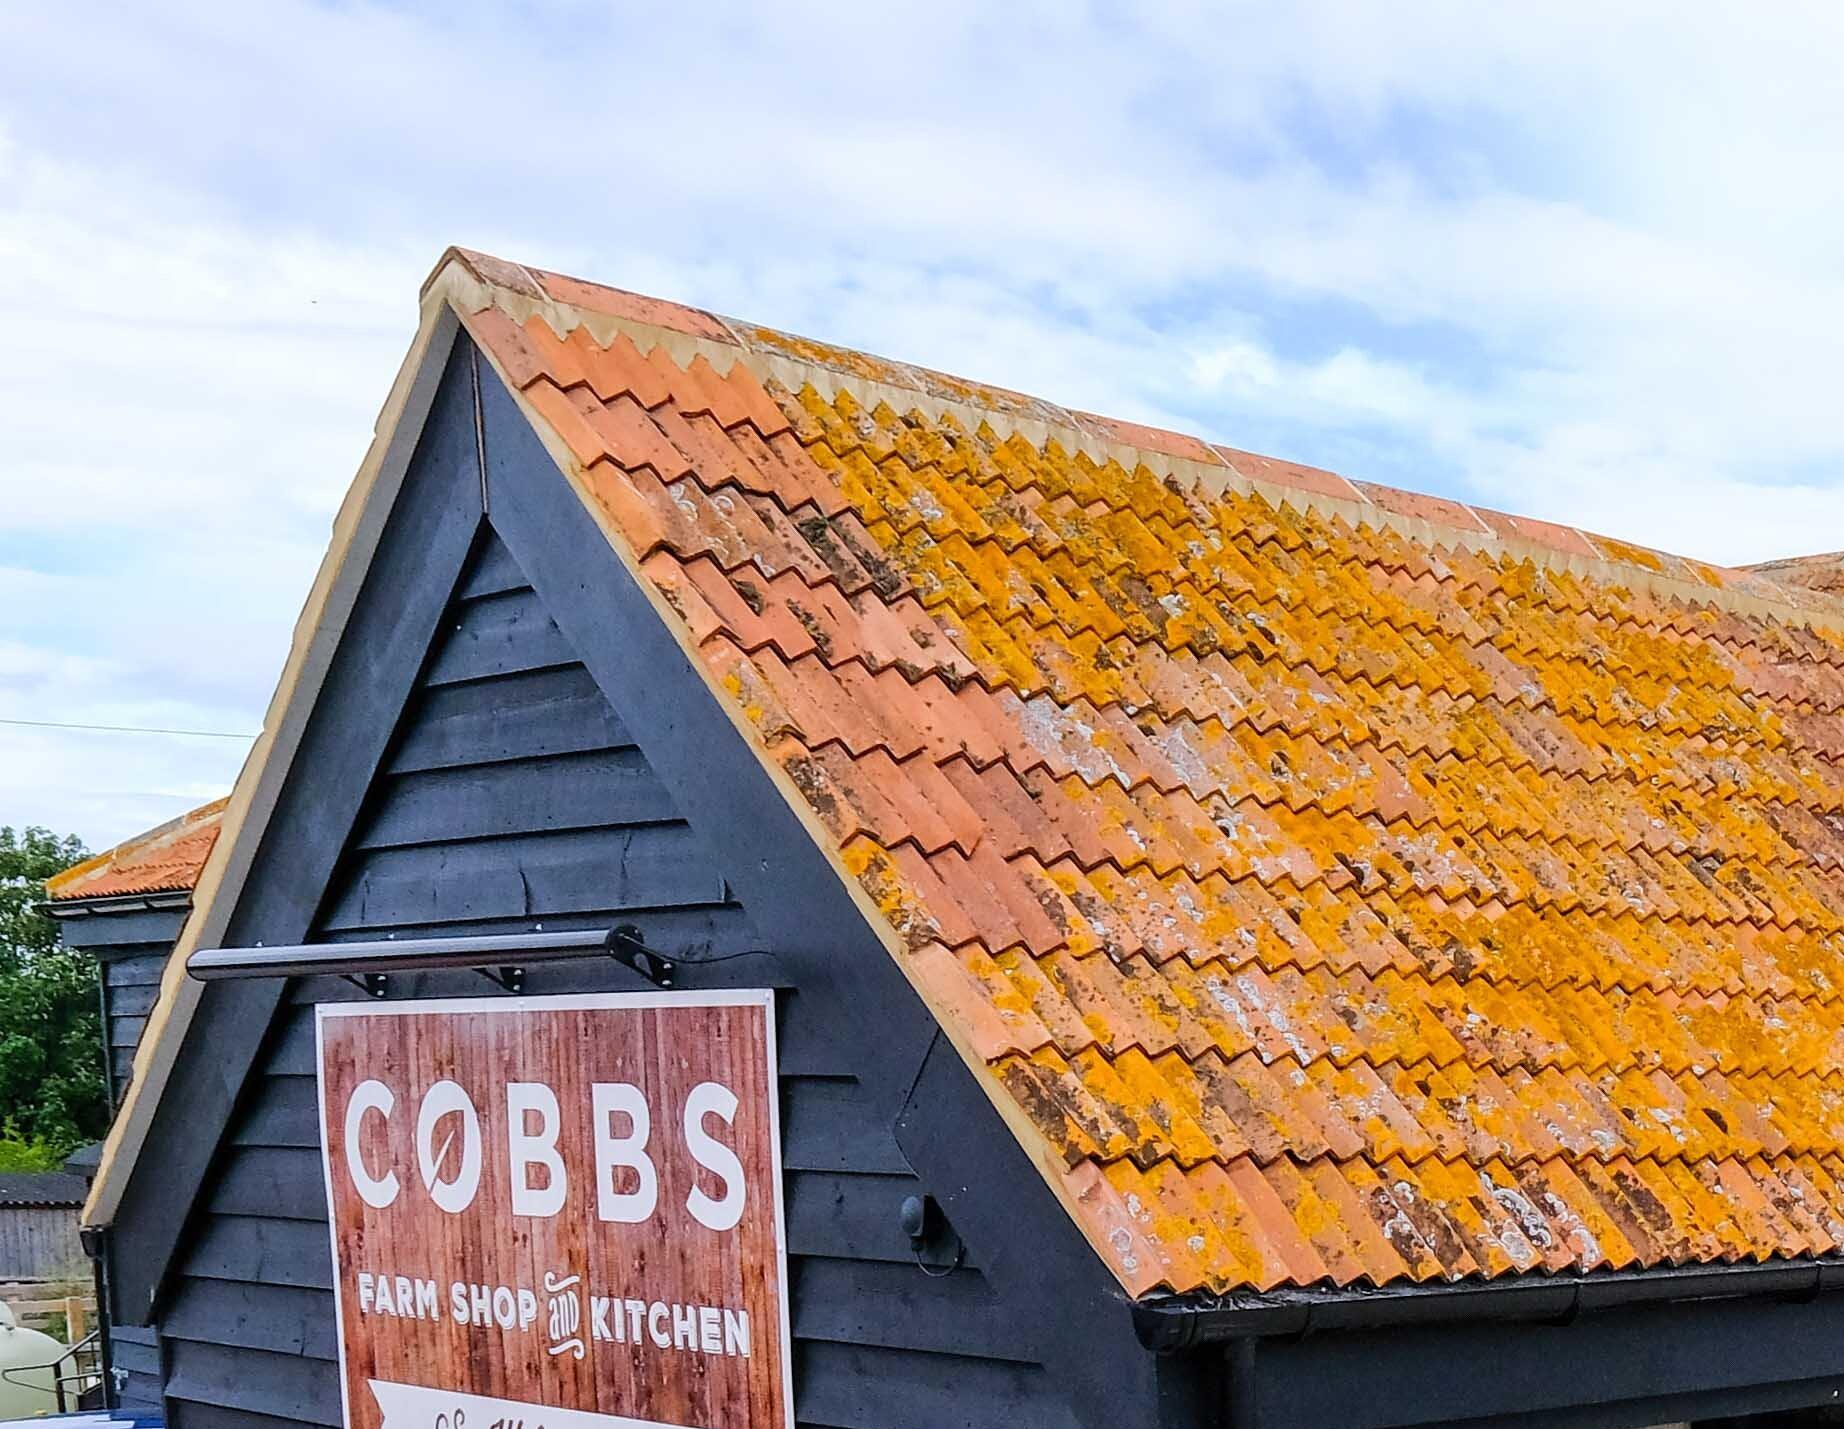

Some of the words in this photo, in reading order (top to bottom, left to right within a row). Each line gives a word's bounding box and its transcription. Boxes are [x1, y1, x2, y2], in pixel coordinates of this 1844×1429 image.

[344, 1079, 746, 1231] COBBS
[358, 1271, 438, 1321] FARM
[452, 1284, 537, 1332] SHOP
[590, 1297, 751, 1358] KITCHEN
